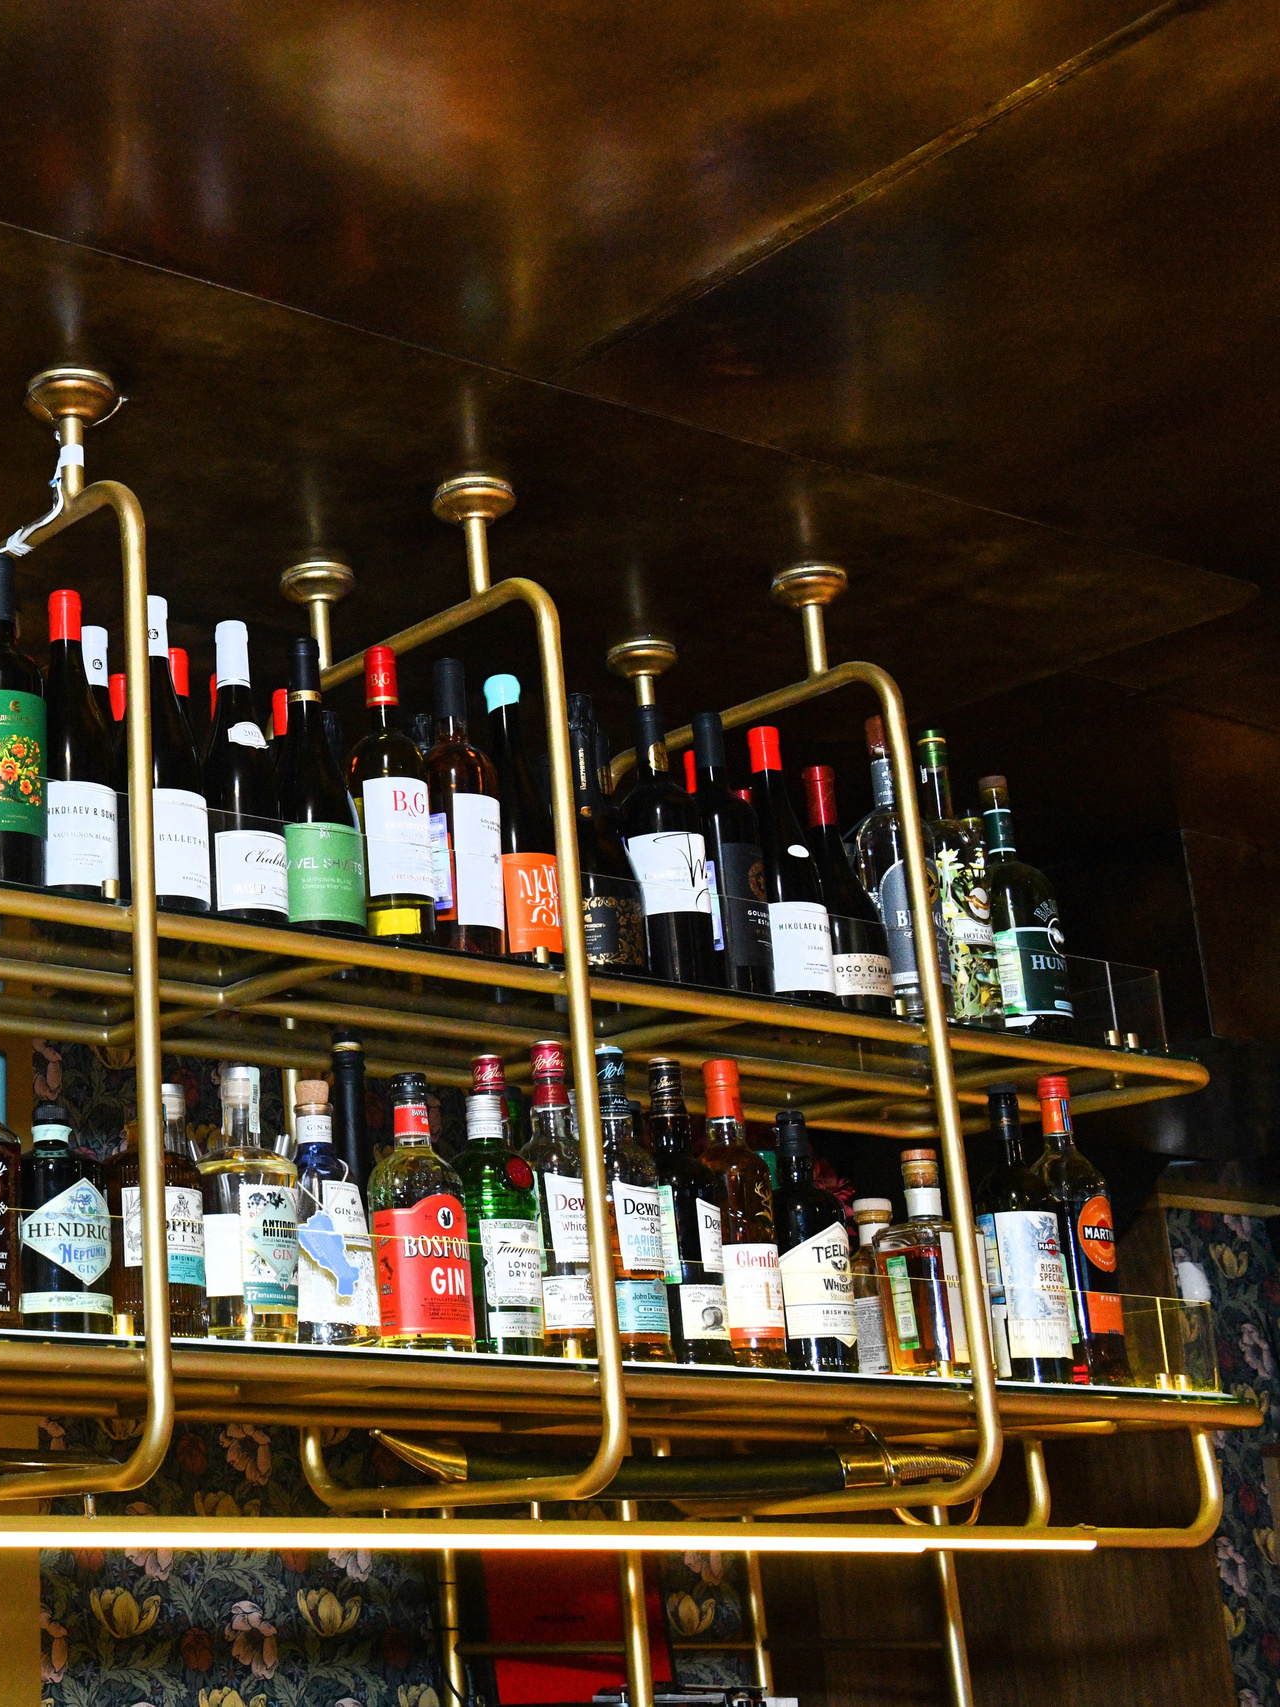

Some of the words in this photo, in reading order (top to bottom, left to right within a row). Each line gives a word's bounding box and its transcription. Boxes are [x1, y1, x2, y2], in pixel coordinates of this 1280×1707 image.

[392, 790, 425, 817] B&G
[95, 834, 112, 843] BLANC
[778, 922, 817, 931] NIKOLAEV
[836, 965, 862, 973] OCO
[334, 1207, 351, 1215] GIN
[623, 1198, 660, 1216] Dewa
[562, 1221, 587, 1232] White
[650, 1222, 656, 1234] 8
[627, 1234, 662, 1247] CARIBBE
[58, 1243, 107, 1265] NEPTUNIA
[273, 1249, 293, 1260] GIN
[636, 1246, 663, 1257] SMOO
[170, 1255, 196, 1263] ORIGINAL
[736, 1251, 780, 1269] Glenfid
[77, 1264, 98, 1274] GIN
[508, 1261, 540, 1270] LONDON
[508, 1270, 527, 1278] DRY
[430, 1267, 466, 1297] GIN
[823, 1278, 853, 1292] WHISKE
[246, 1290, 258, 1300] 17
[632, 1292, 647, 1300] John
[706, 1298, 718, 1306] John
